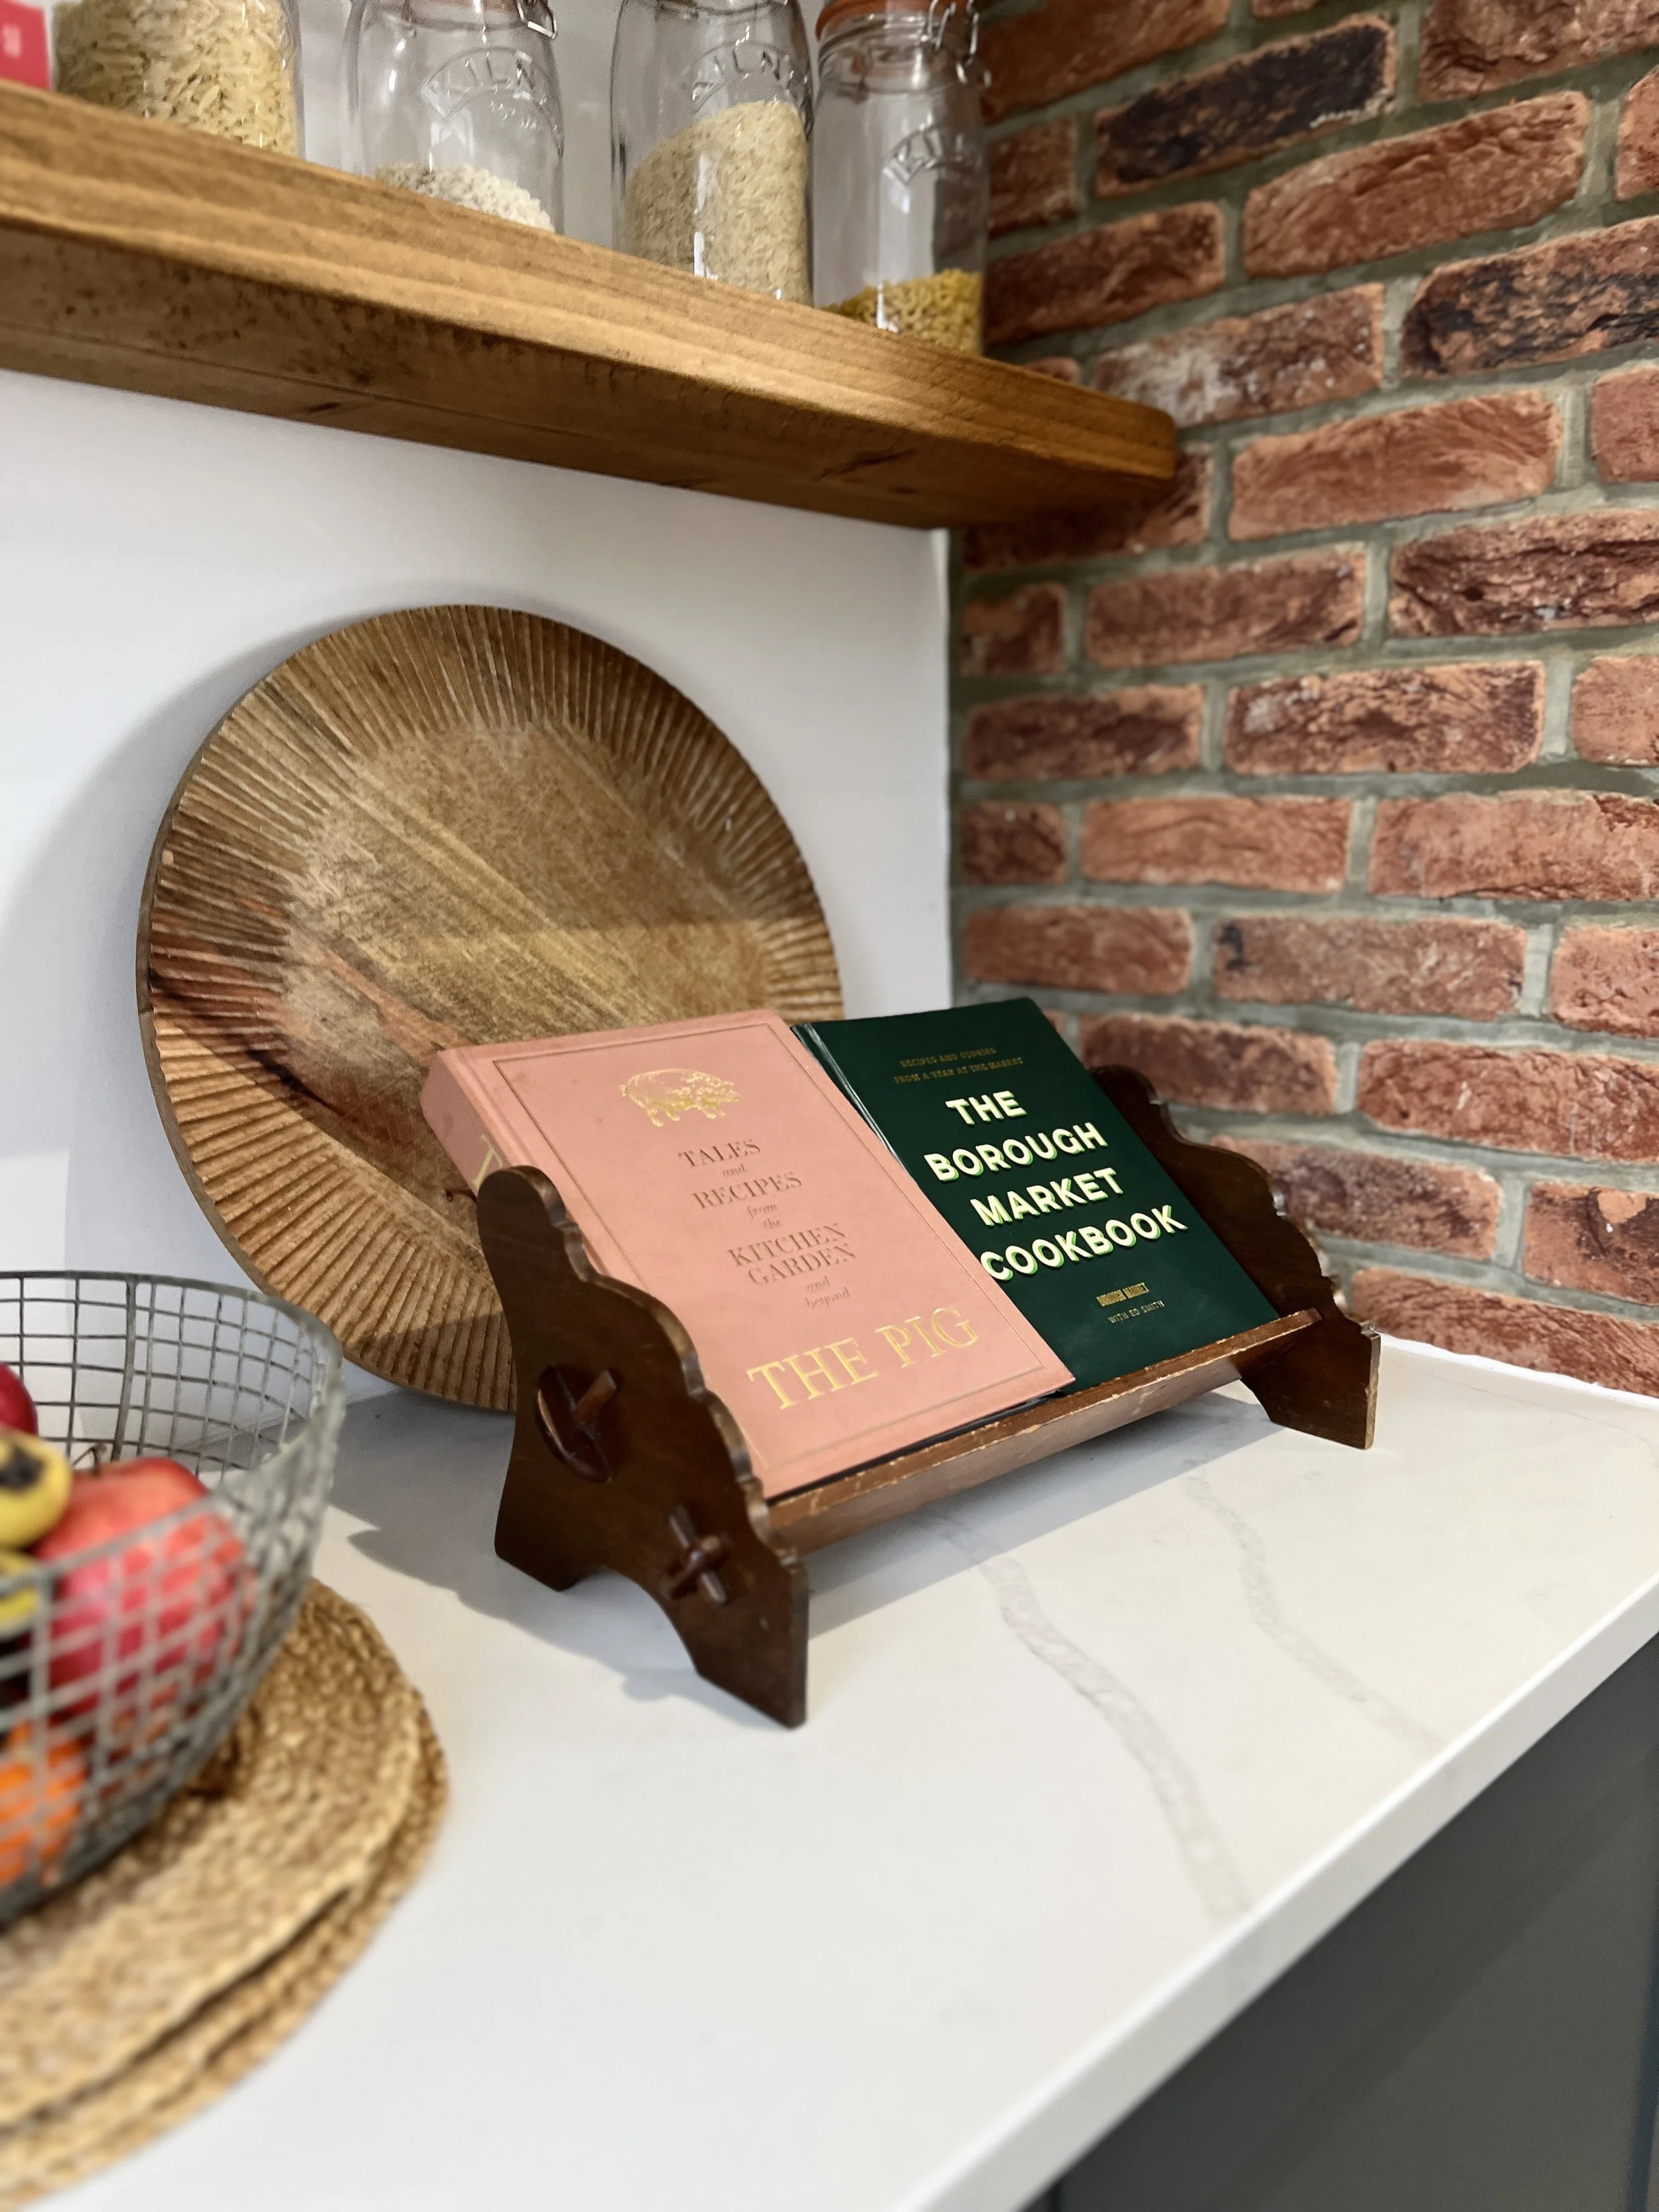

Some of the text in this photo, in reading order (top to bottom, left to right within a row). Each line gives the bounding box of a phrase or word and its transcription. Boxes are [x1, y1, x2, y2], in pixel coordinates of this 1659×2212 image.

[945, 1090, 1027, 1125] THE
[678, 1138, 760, 1168] TALES
[924, 1122, 1108, 1182] BOROUGH
[723, 1164, 747, 1177] and
[692, 1171, 802, 1210] RECIPES
[970, 1167, 1123, 1226] MARKET
[747, 1204, 778, 1220] from
[763, 1218, 783, 1229] the
[728, 1222, 846, 1268] KITCHEN
[980, 1205, 1189, 1281] COOKBOOK
[748, 1243, 856, 1284] GARDEN
[804, 1286, 849, 1309] beyond
[806, 1275, 830, 1293] and
[1108, 1300, 1165, 1323] WITH ED SMITH
[747, 1305, 978, 1410] THE PIG
